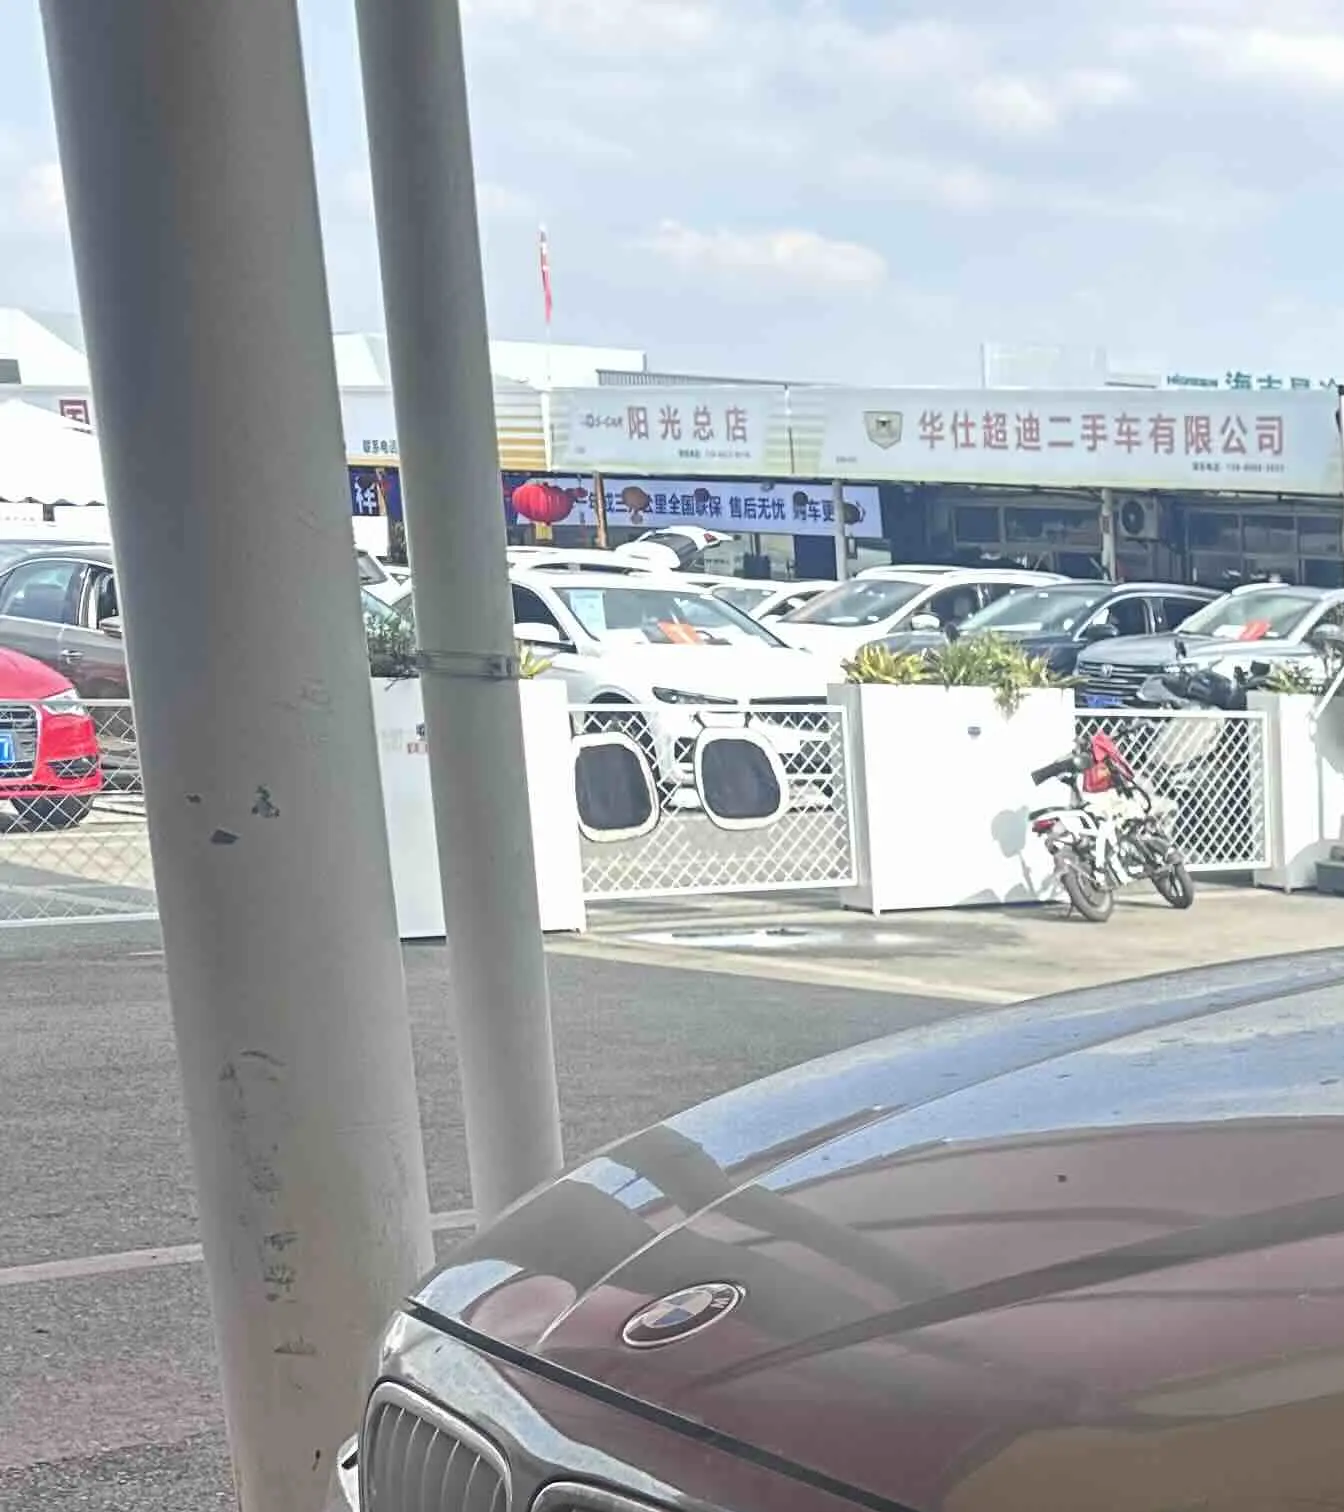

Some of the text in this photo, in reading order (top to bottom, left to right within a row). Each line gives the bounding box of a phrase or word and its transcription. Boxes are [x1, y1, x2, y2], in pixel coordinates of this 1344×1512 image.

[627, 404, 748, 442] 阳光总店
[919, 409, 1284, 456] 华仕超迪二手车有限公司
[729, 496, 785, 521] 售后无忧
